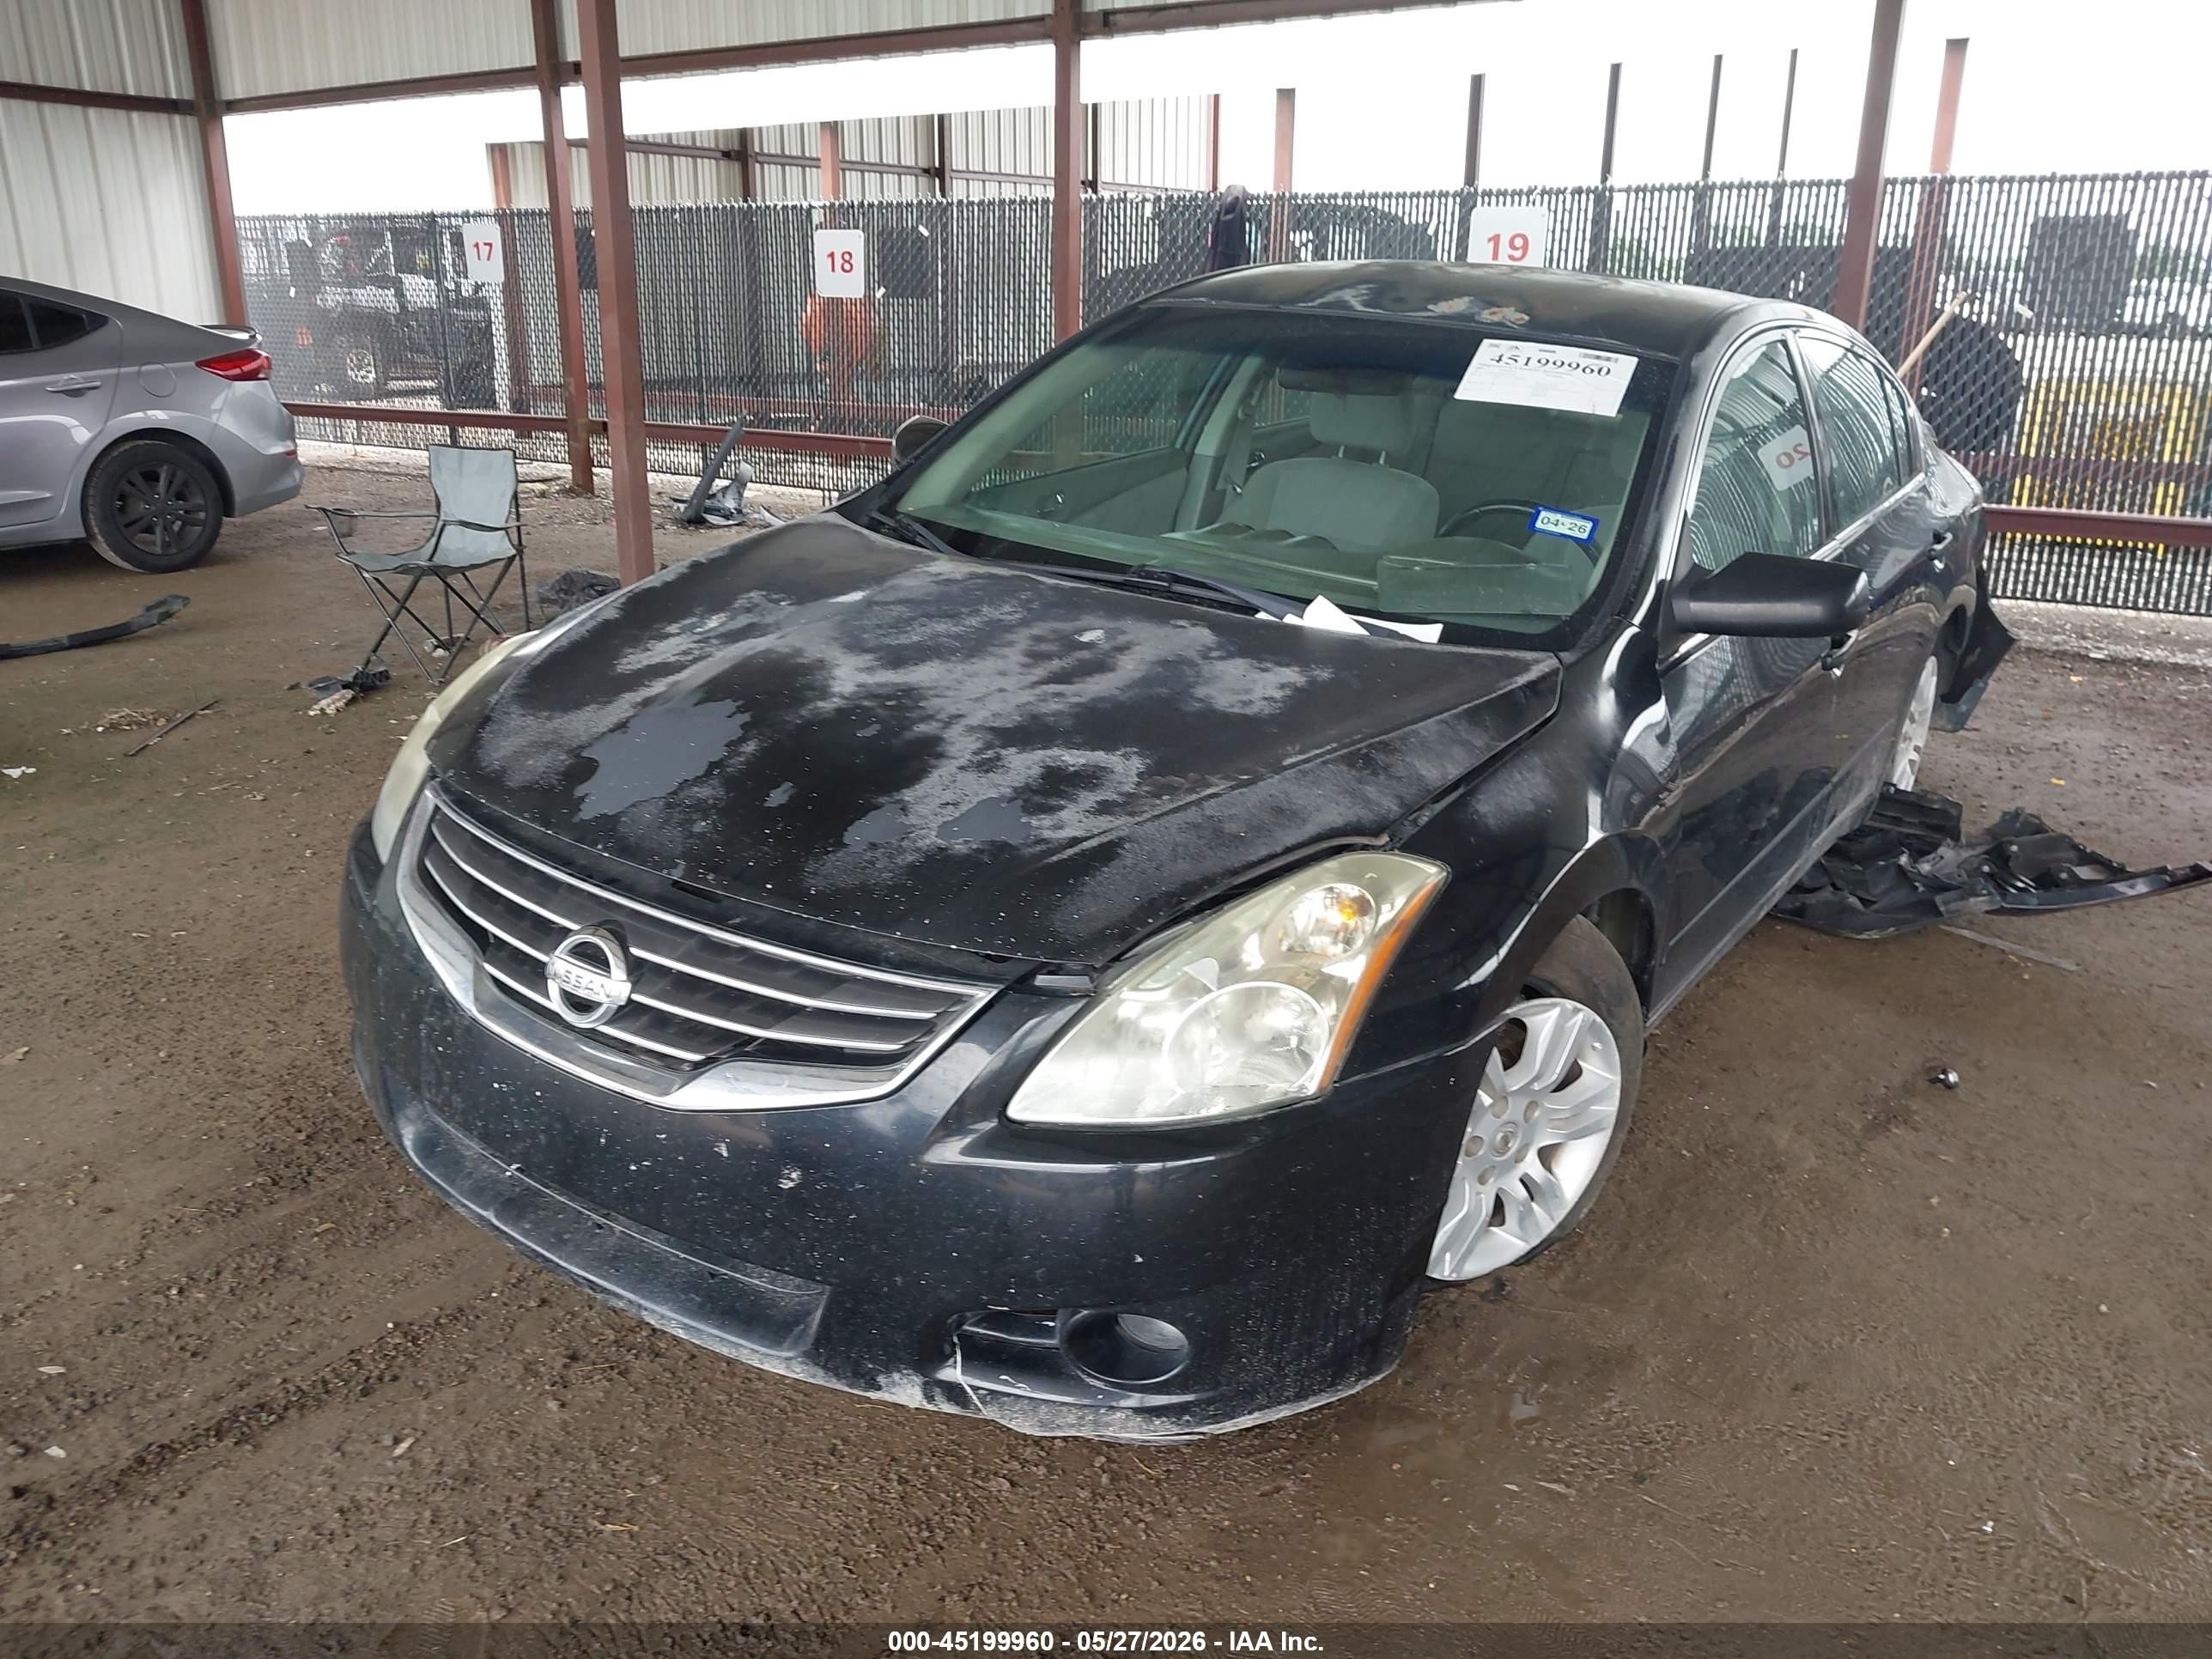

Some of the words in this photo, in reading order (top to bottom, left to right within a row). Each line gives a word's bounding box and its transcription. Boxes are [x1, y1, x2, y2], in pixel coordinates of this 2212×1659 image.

[473, 241, 493, 262] 17
[1486, 233, 1529, 262] 19
[827, 251, 854, 273] 18
[1490, 353, 1612, 378] 45199960
[553, 968, 613, 999] SSAN
